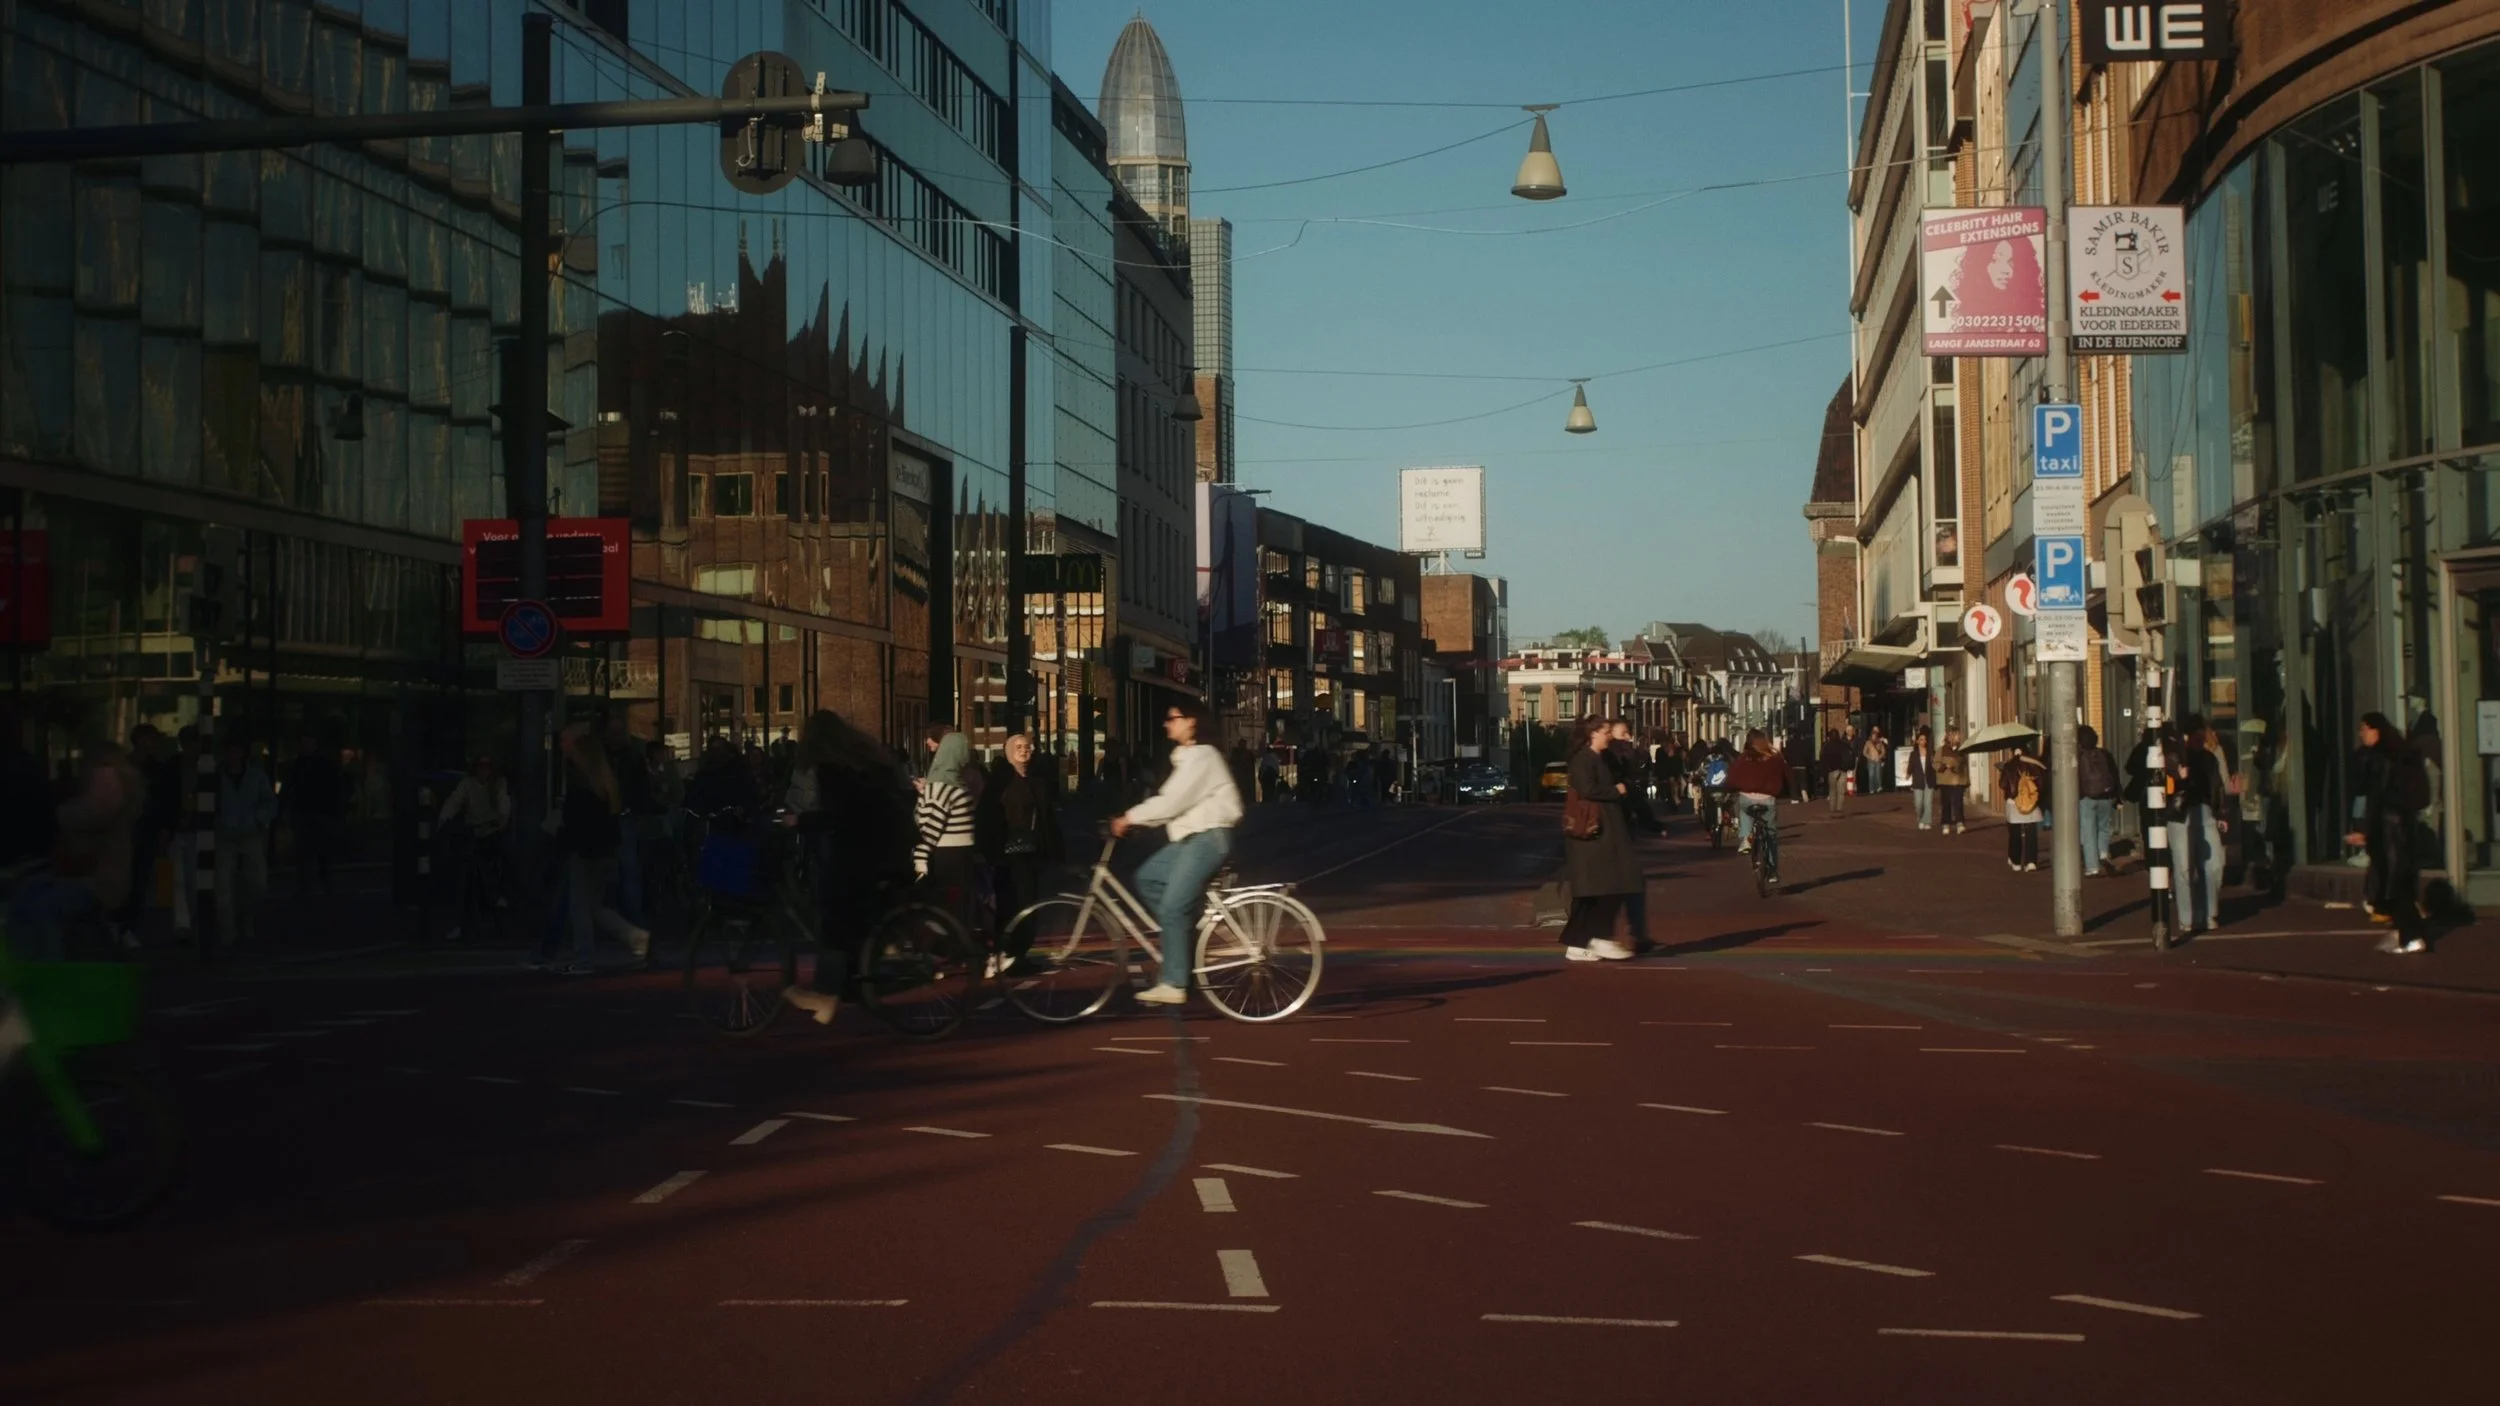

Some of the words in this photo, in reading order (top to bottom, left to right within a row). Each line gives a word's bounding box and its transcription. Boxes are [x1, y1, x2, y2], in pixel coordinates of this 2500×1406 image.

[2105, 4, 2204, 50] WE
[1925, 216, 1988, 236] CELEBRITY
[1991, 212, 2023, 226] HAIR
[1960, 222, 2039, 244] EXTENSIONS
[2085, 211, 2125, 256] SAMIR
[2130, 211, 2169, 256] BAKIR
[2122, 256, 2133, 275] S
[2090, 271, 2167, 300] KLEDINGMAKER
[1957, 315, 2039, 327] 0302231500
[2080, 306, 2179, 317] KLEDINGMAKER
[2080, 320, 2117, 331] VOOR
[1929, 339, 1962, 349] LANGE
[1964, 339, 2026, 348] JANSSTRAAT
[2028, 339, 2041, 348] 63
[2078, 336, 2093, 348] IN
[2095, 336, 2113, 348] DE
[2114, 336, 2183, 348] BIJENKORF
[2045, 411, 2071, 447] P
[2040, 456, 2079, 471] taxi
[483, 531, 510, 542] Voor
[2047, 542, 2073, 578] P
